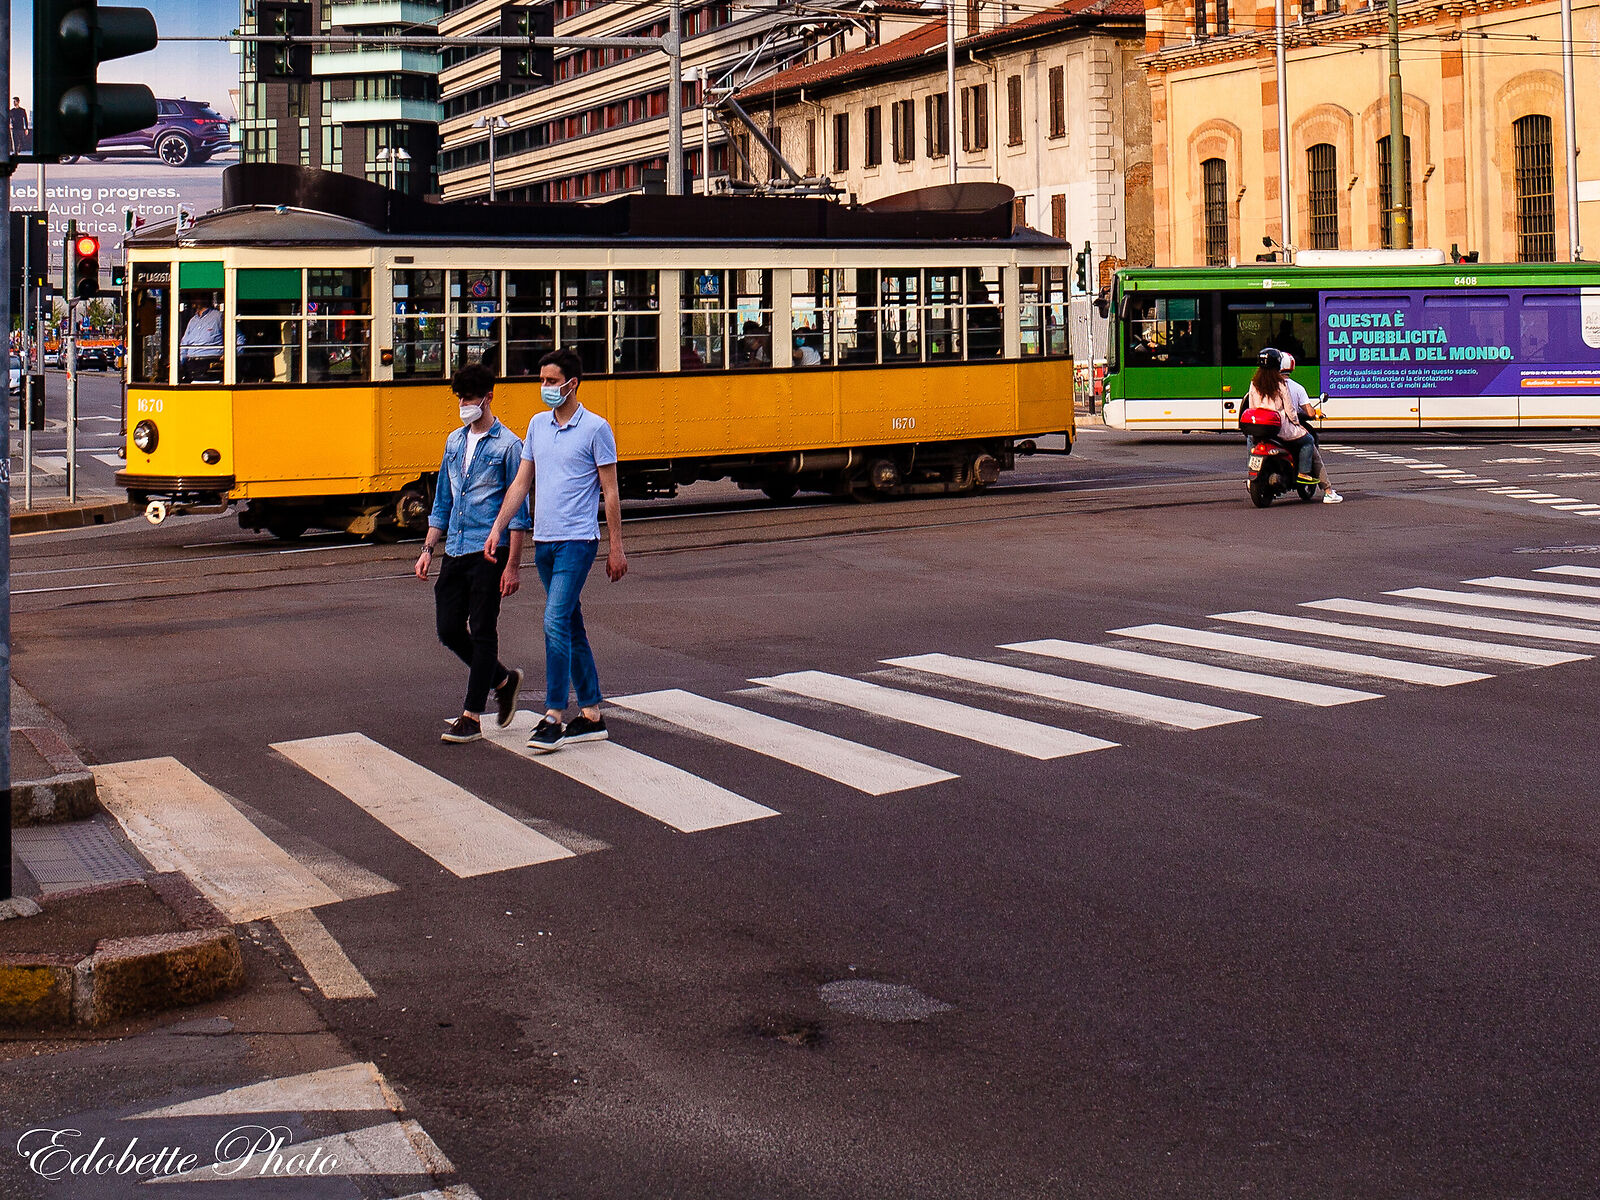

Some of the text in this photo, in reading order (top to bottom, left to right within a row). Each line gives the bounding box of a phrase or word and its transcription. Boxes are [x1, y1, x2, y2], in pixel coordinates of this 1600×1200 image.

[98, 188, 181, 201] progress.
[48, 203, 86, 215] Audi
[92, 202, 117, 216] Q4
[1454, 276, 1477, 285] 6408
[1328, 310, 1405, 328] QUESTA È
[1328, 326, 1448, 344] LA PUBBLICITÀ
[1328, 345, 1514, 362] PIÙ BELLA DEL MONDO.
[1353, 369, 1382, 377] qualsiasi
[138, 398, 164, 412] 1670
[892, 417, 916, 430] 1670
